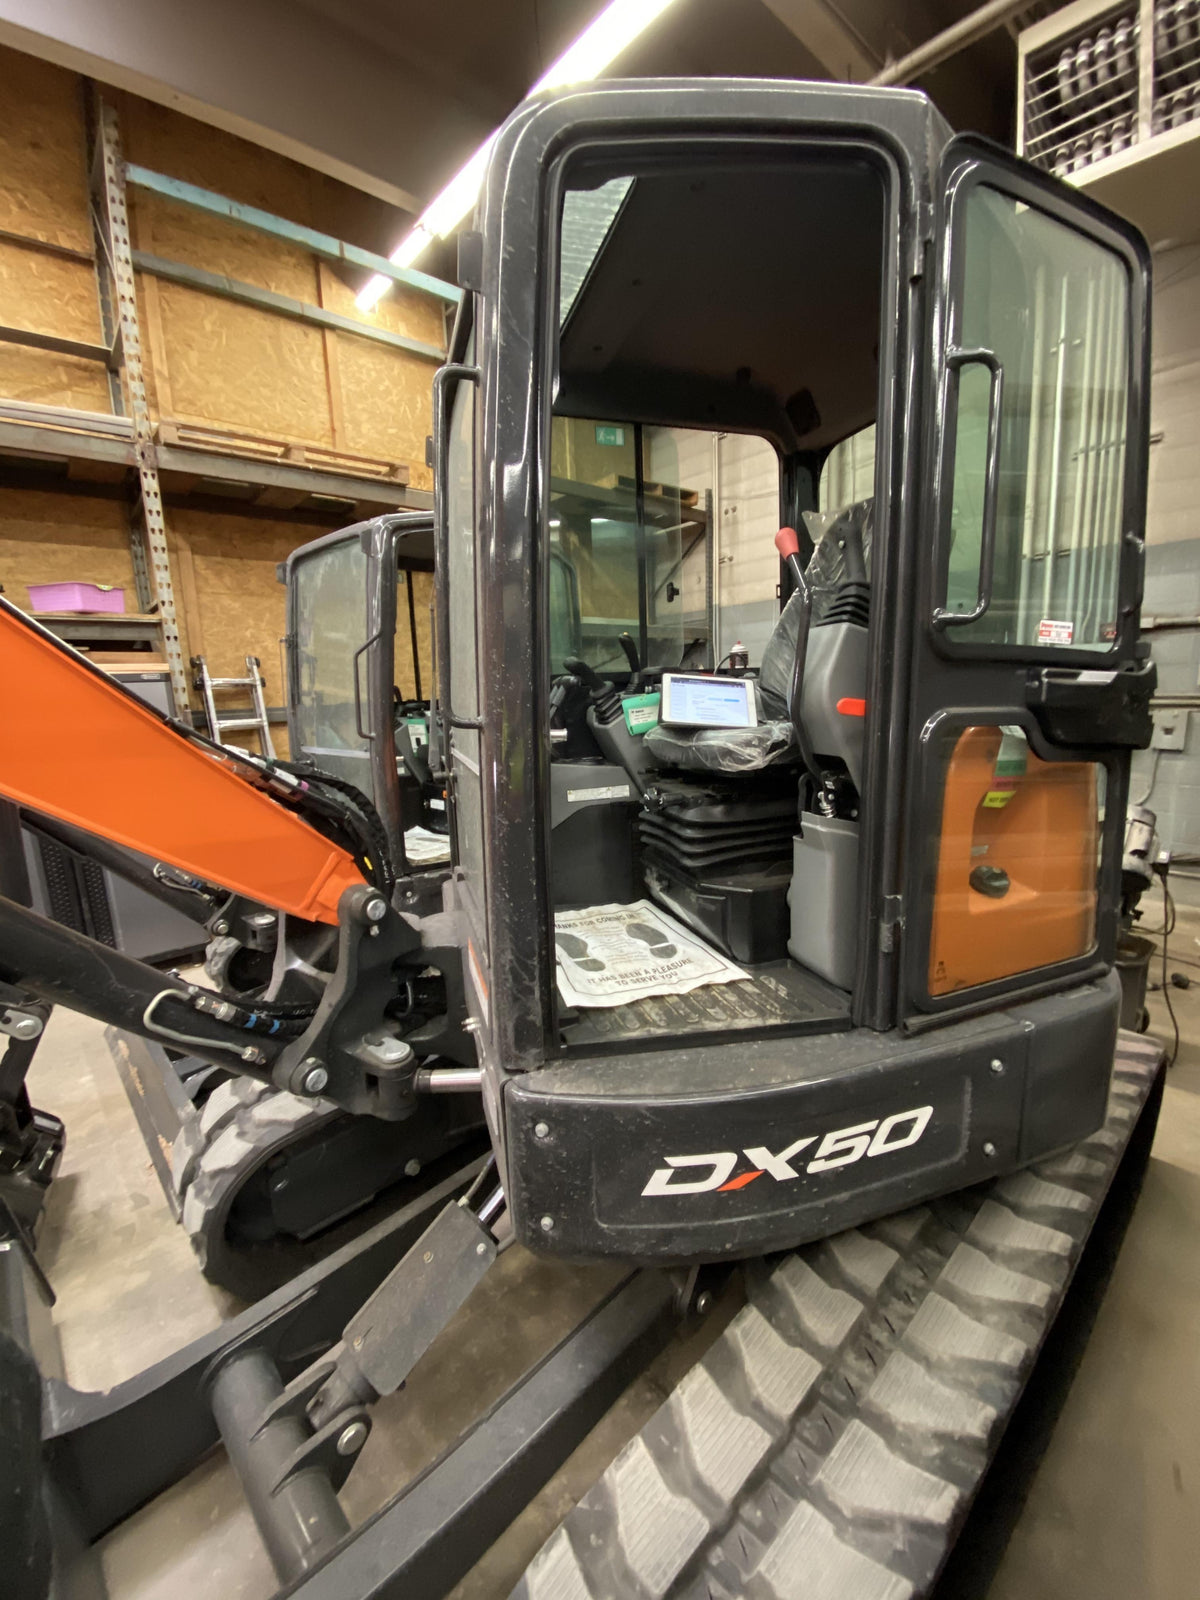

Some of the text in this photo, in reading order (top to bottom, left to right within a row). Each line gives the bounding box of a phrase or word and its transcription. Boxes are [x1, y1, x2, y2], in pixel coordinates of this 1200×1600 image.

[596, 914, 626, 923] COMING
[598, 975, 617, 983] HAS
[618, 969, 643, 979] BEEN
[644, 967, 651, 975] A
[652, 957, 695, 975] PLEASURE
[629, 975, 659, 985] SERVE
[659, 970, 679, 980] YOU
[641, 1105, 934, 1196] DX50
